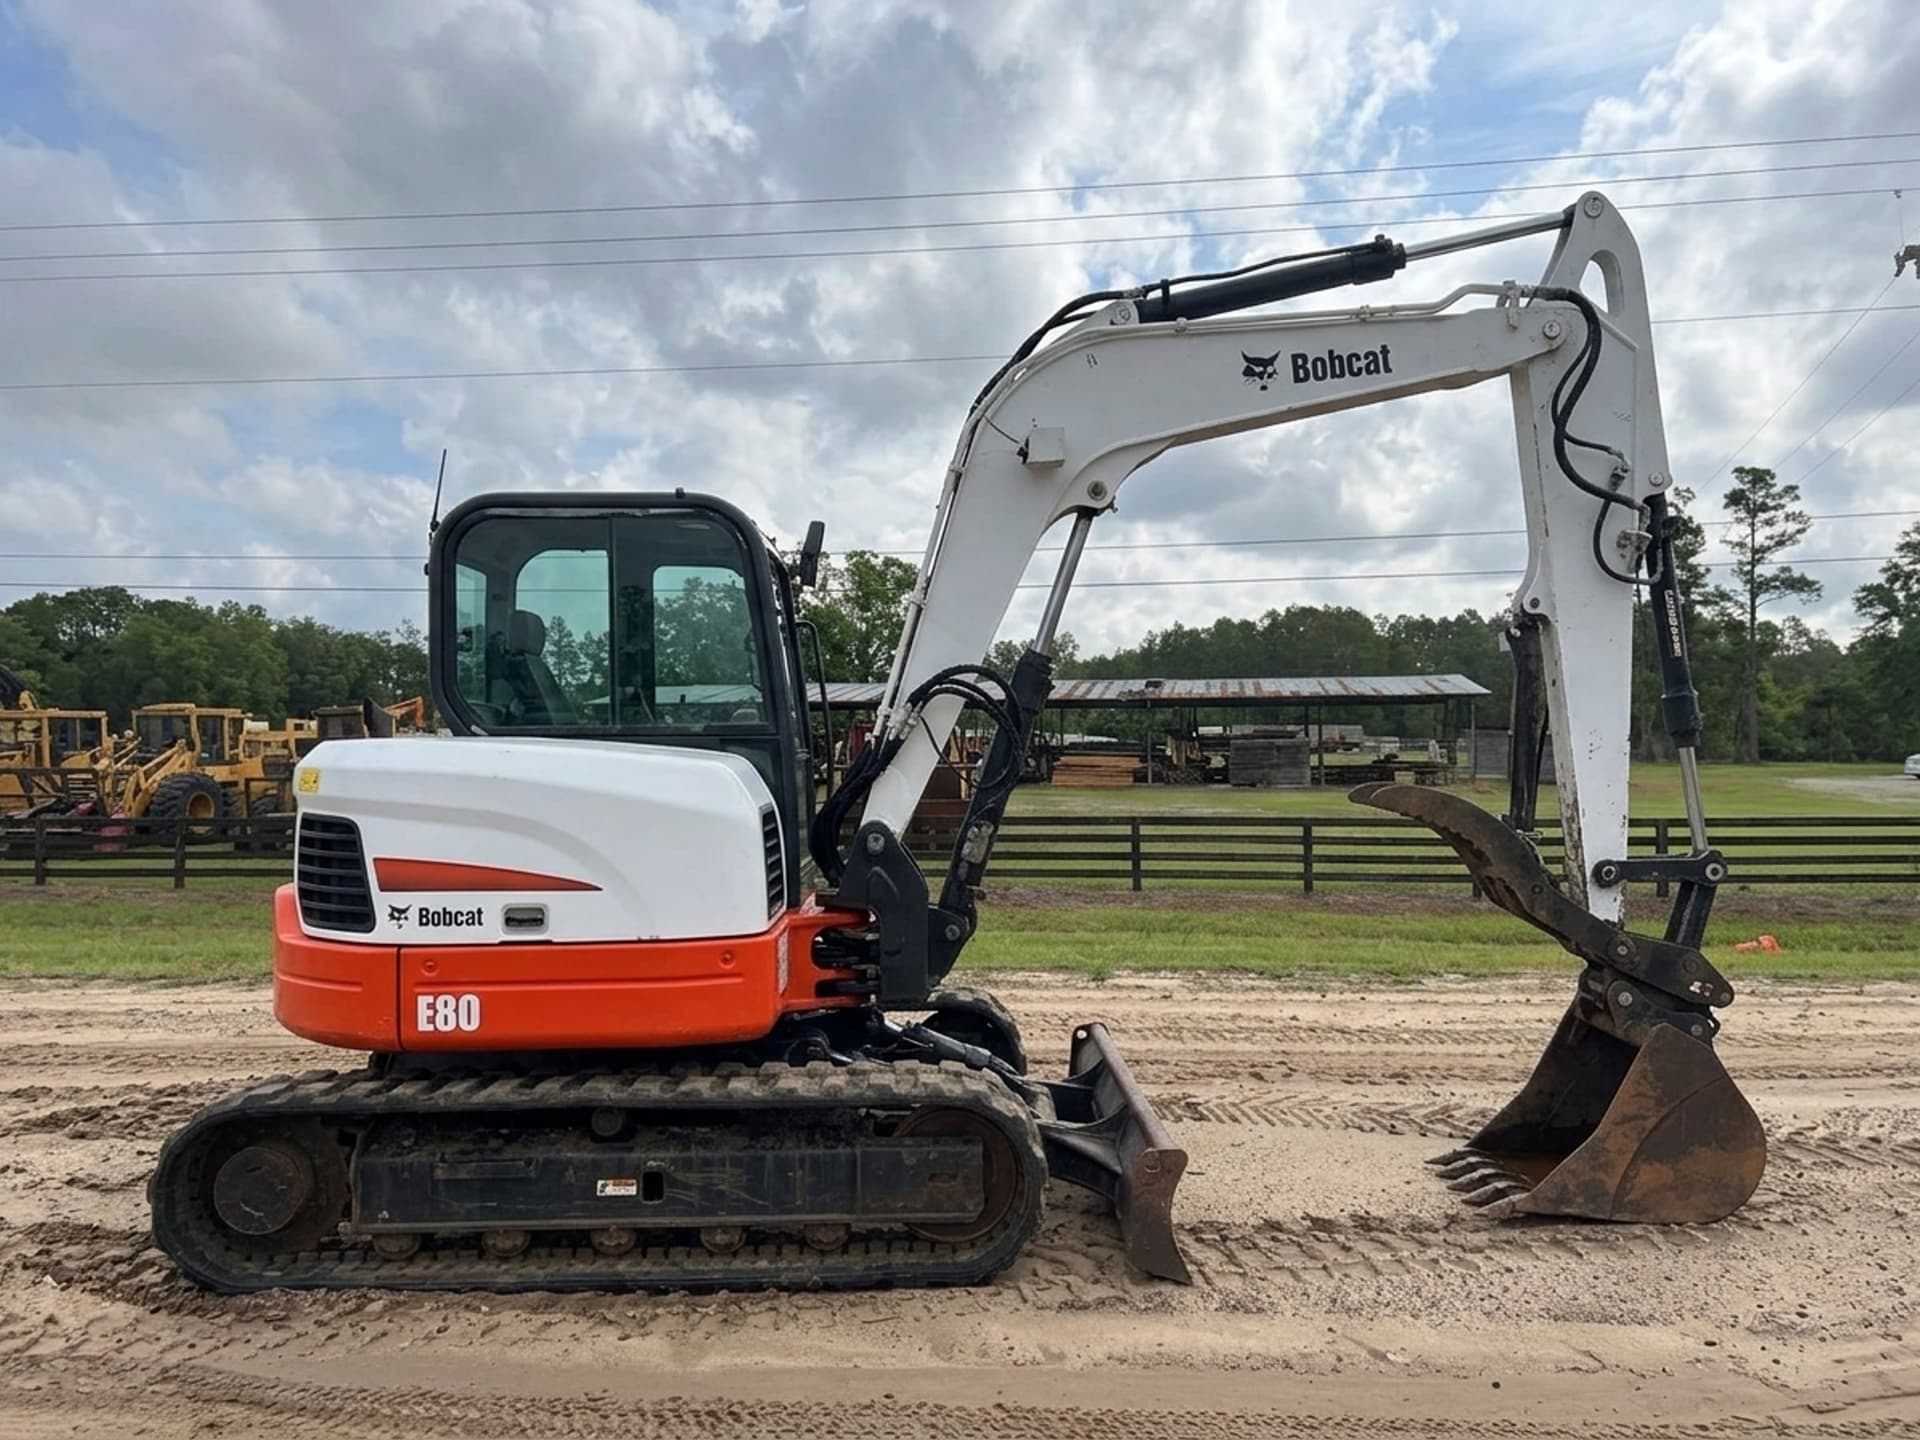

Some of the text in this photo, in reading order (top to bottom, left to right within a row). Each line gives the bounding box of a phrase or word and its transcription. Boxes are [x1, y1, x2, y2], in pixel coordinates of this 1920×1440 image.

[1291, 344, 1392, 384] Bobcat
[418, 907, 484, 928] Bobcat
[417, 994, 481, 1032] E80
